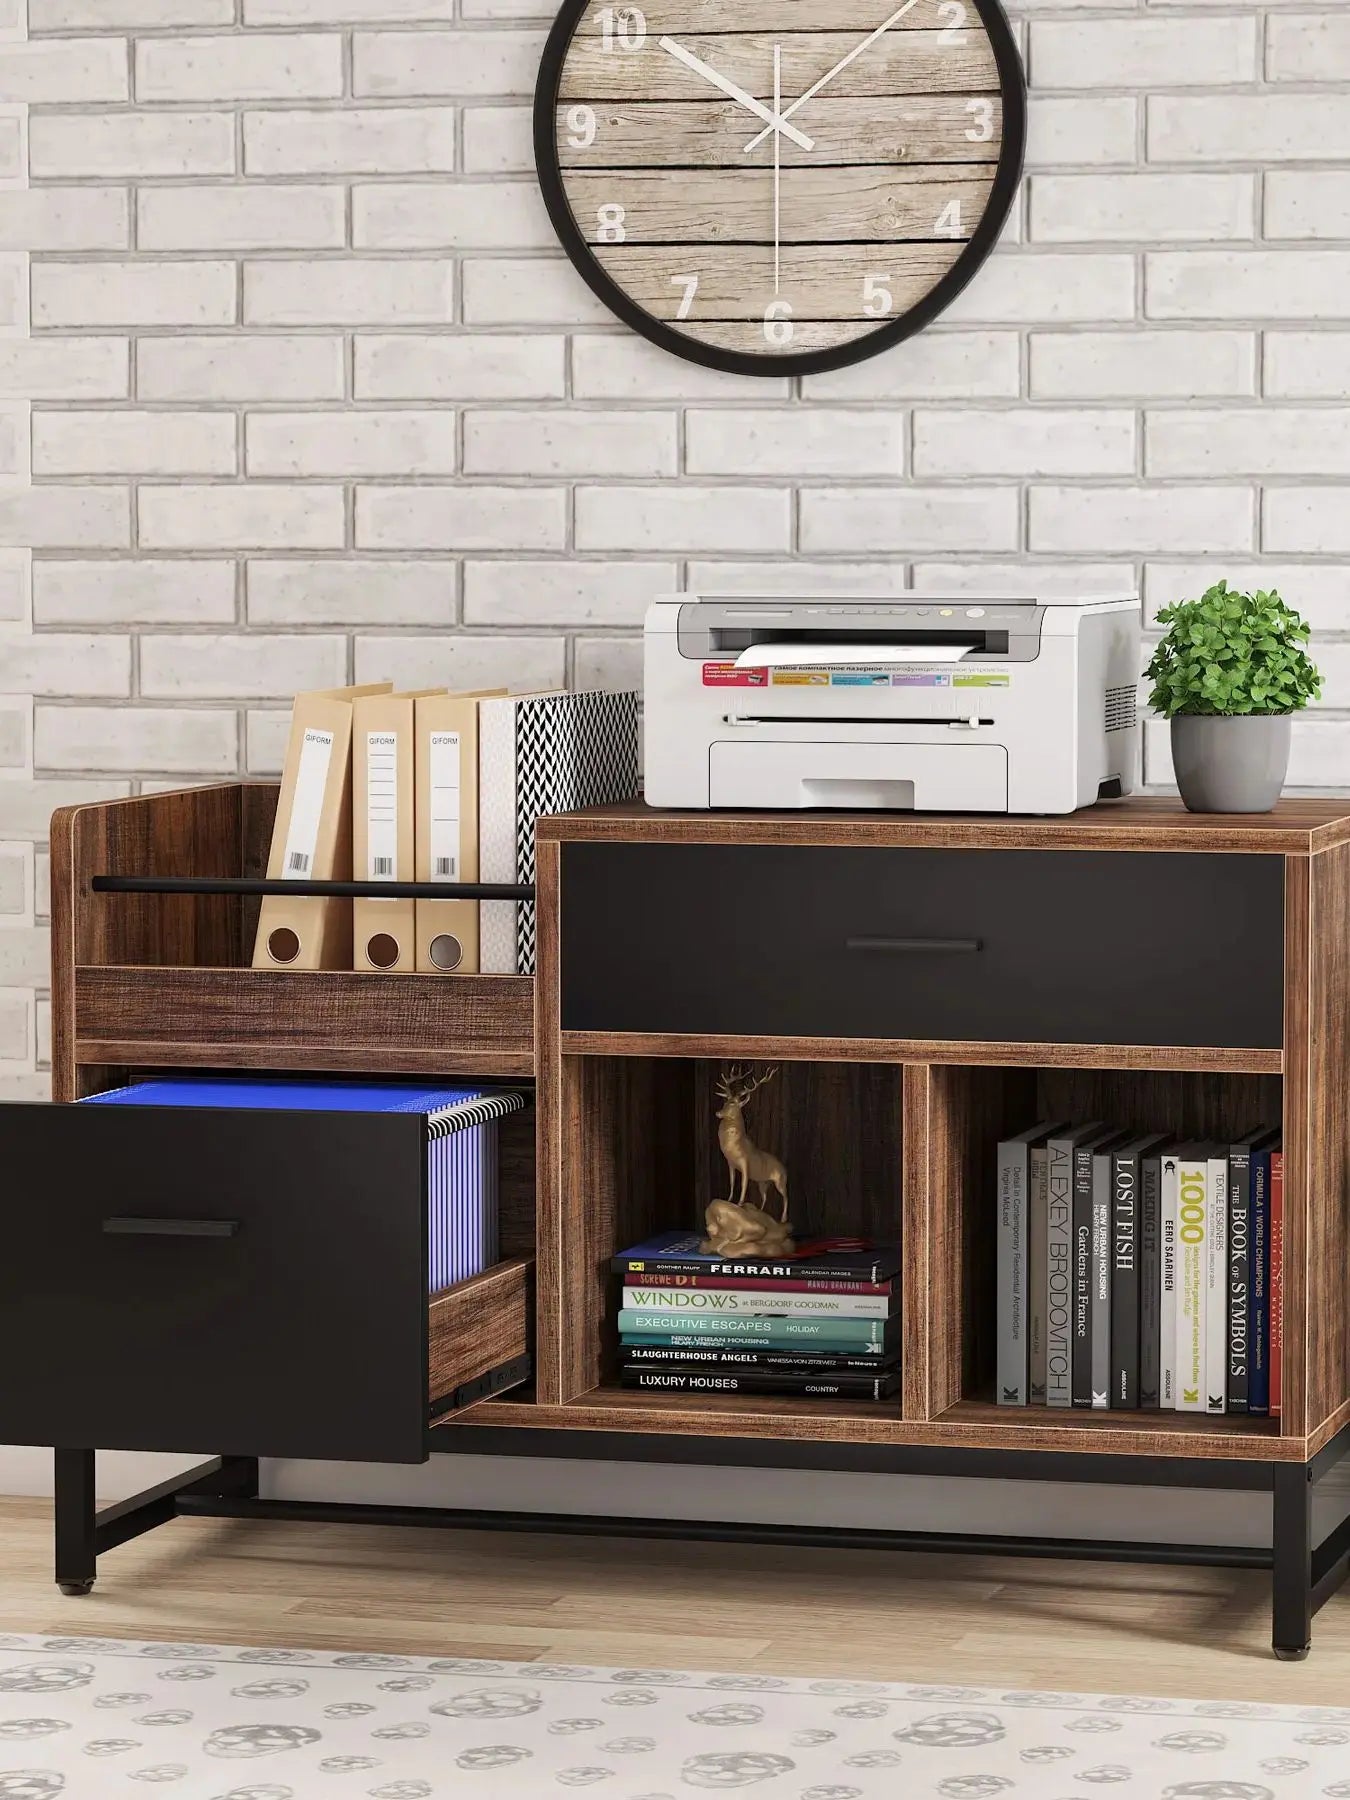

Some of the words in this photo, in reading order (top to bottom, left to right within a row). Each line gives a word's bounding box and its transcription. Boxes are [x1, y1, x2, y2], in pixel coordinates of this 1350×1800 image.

[592, 7, 647, 54] 10
[936, 1, 968, 46] 2
[565, 104, 596, 149] 9
[964, 97, 995, 142] 3
[595, 203, 626, 244] 8
[933, 199, 966, 239] 4
[670, 276, 699, 320] 7
[862, 276, 894, 317] 5
[763, 301, 795, 345] 6
[305, 734, 332, 745] GIFORM
[369, 737, 395, 746] GIFORM
[431, 737, 458, 746] GIFORM
[1002, 1167, 1010, 1195] Virginia
[1049, 1147, 1069, 1236] ALEXEY
[1116, 1158, 1134, 1216] LOST
[1144, 1170, 1156, 1233] MAKING
[1216, 1173, 1225, 1204] TEXTILE
[1232, 1185, 1240, 1204] THE
[1256, 1166, 1264, 1207] FORMULA
[1011, 1198, 1021, 1251] Contemporary
[1099, 1204, 1107, 1225] NEW
[1180, 1170, 1205, 1244] 1000
[1099, 1226, 1107, 1258] URBAN
[1116, 1219, 1134, 1271] FISH
[1144, 1236, 1155, 1253] IT
[1165, 1220, 1174, 1243] EERO
[1216, 1206, 1225, 1251] DESIGNERS
[1231, 1208, 1247, 1262] BOOK
[1256, 1215, 1264, 1246] WORLD
[710, 1264, 791, 1276] FERRARI
[1078, 1225, 1090, 1276] Gardens
[1164, 1246, 1173, 1291] SAARINEN
[1013, 1253, 1021, 1293] Residential
[1078, 1279, 1088, 1292] in
[1099, 1259, 1107, 1299] HOUSING
[1231, 1265, 1239, 1279] OF
[1255, 1247, 1264, 1298] CHAMPIONS
[631, 1292, 738, 1309] WINDOWS
[750, 1298, 794, 1308] BERGDORF
[794, 1300, 839, 1309] GOODMAN
[1013, 1296, 1021, 1340] Architecture
[1049, 1243, 1069, 1389] BRODOVITCH
[1078, 1295, 1089, 1337] France
[636, 1317, 707, 1329] EXECUTIVE
[711, 1320, 771, 1332] ESCAPES
[786, 1325, 820, 1333] HOLIDAY
[727, 1337, 769, 1345] HOUSING
[1230, 1282, 1247, 1376] SYMBOLS
[631, 1350, 718, 1361] SLAUGHTERHOUSE
[721, 1353, 758, 1362] ANGELS
[640, 1375, 686, 1387] LUXURY
[689, 1377, 738, 1389] HOUSES
[805, 1385, 839, 1393] COUNTRY
